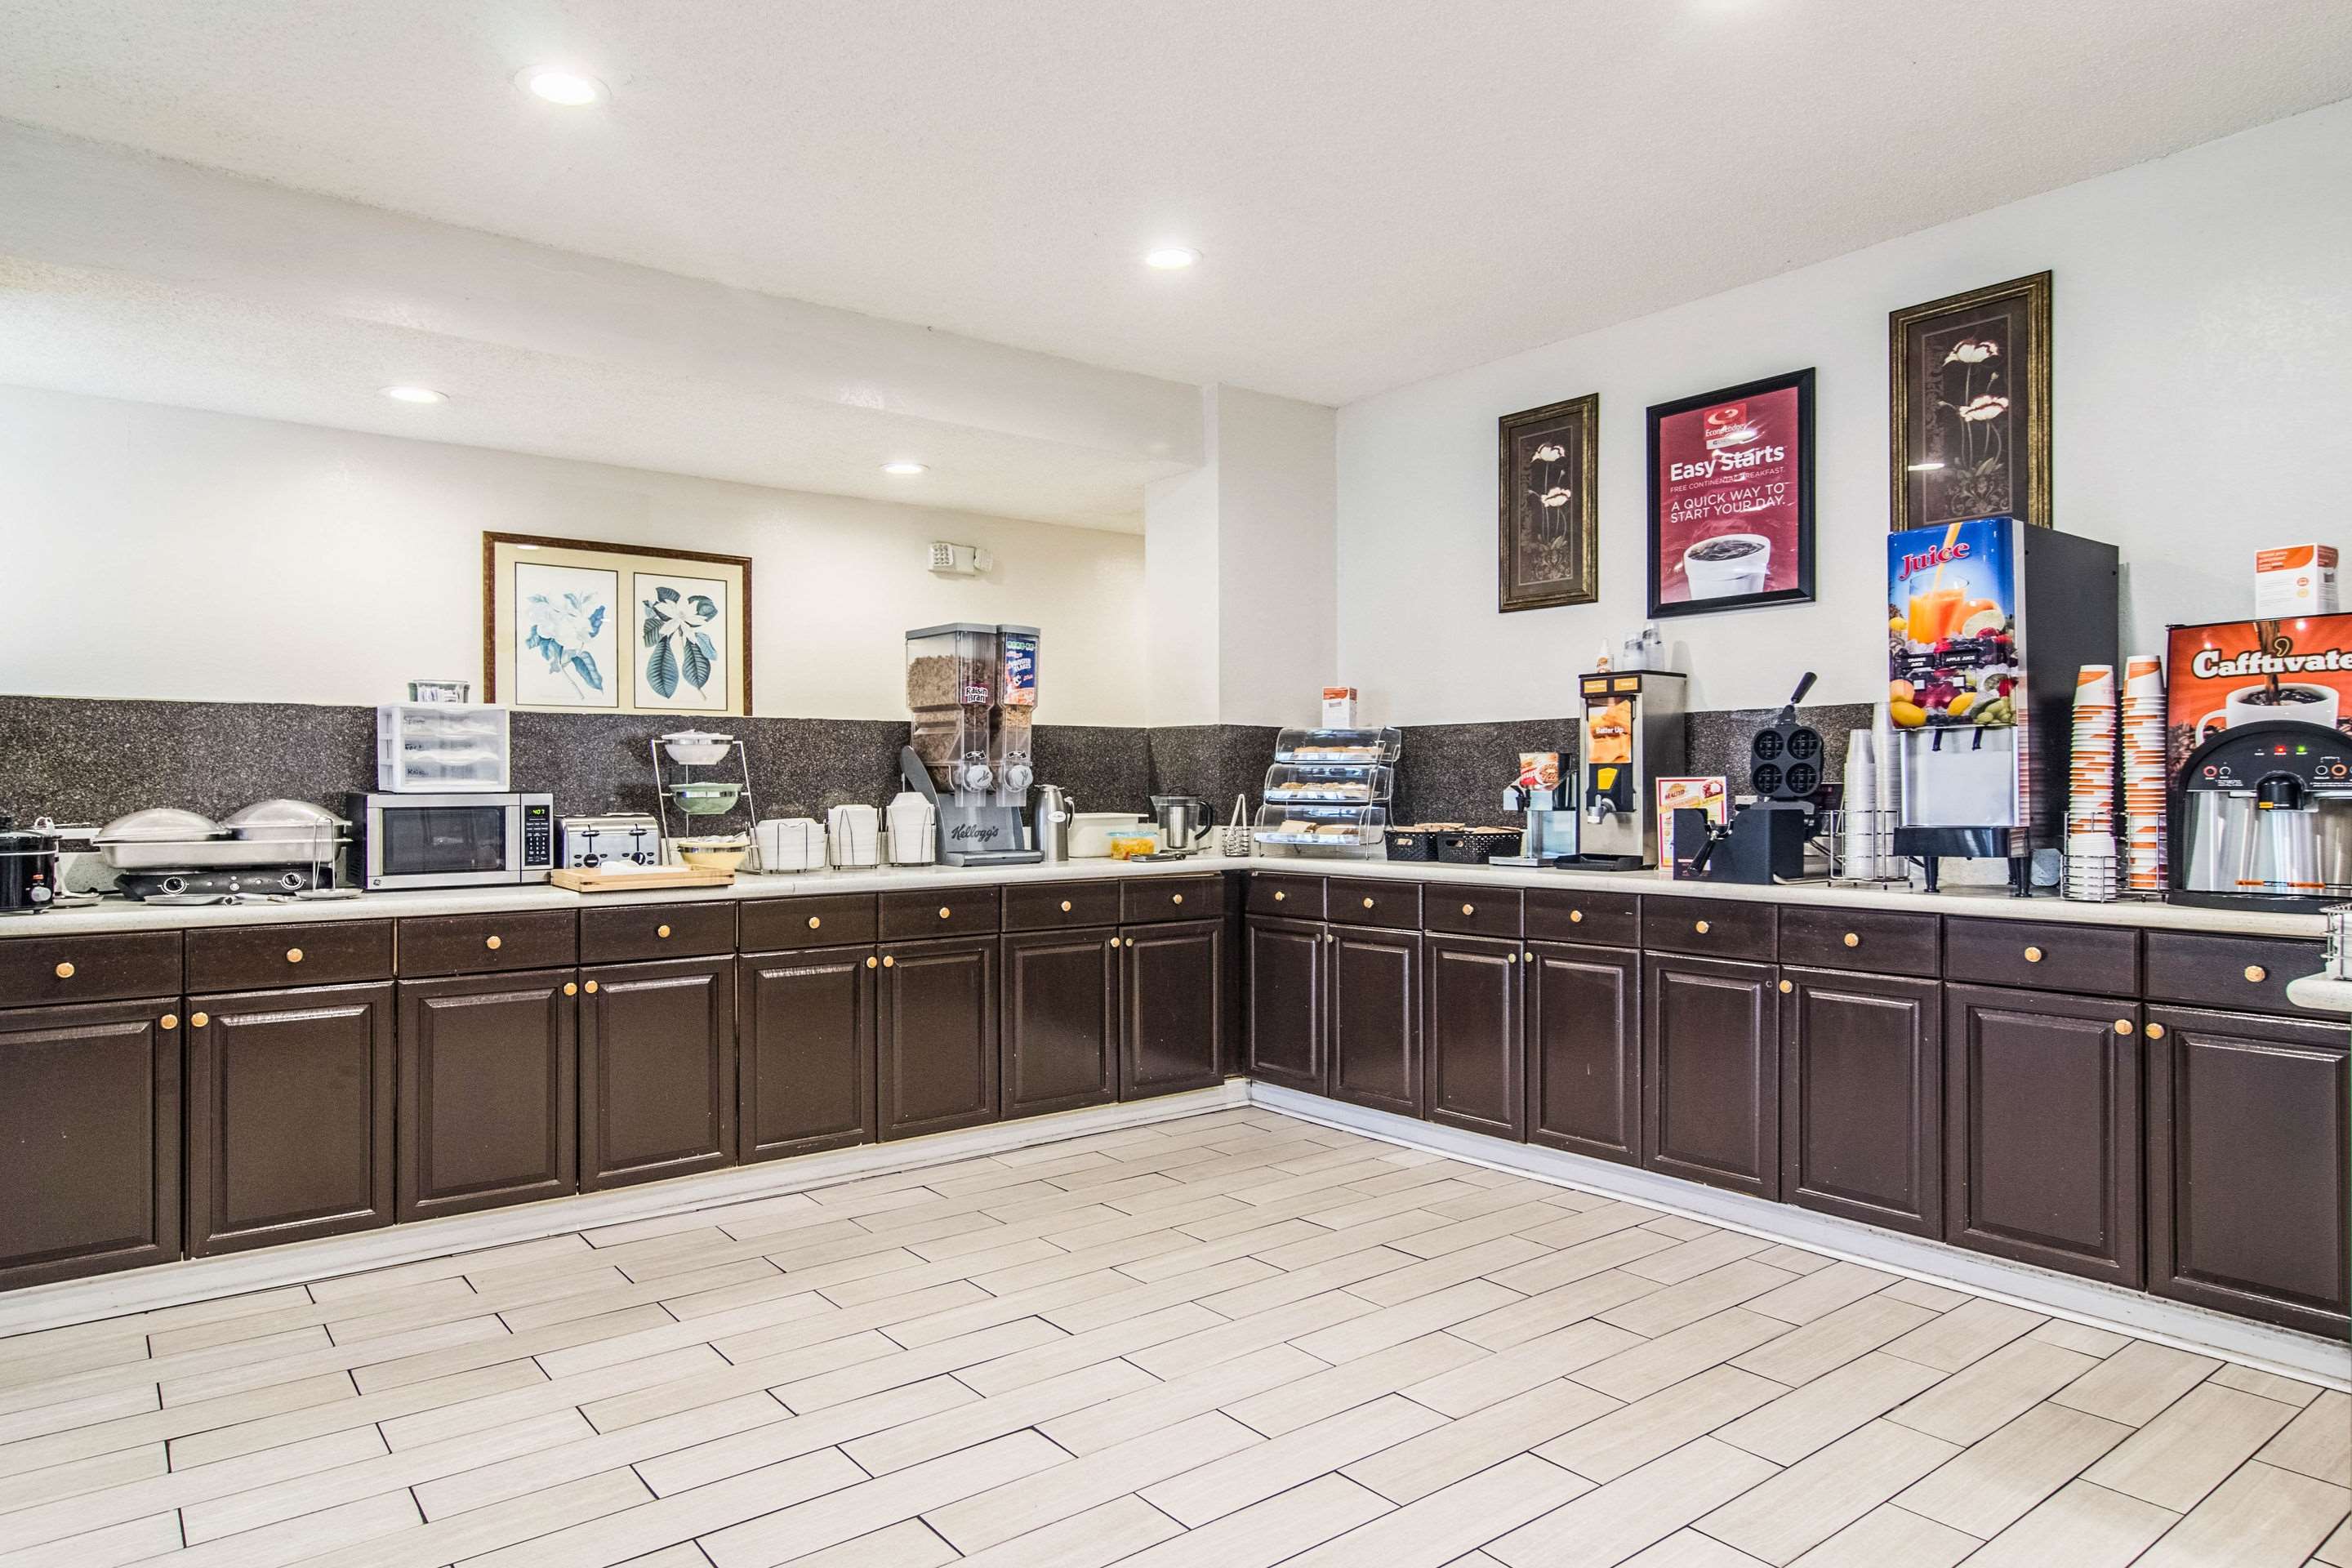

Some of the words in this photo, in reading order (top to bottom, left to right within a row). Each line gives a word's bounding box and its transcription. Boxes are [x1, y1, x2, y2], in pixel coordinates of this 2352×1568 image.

[1671, 459, 1716, 481] Easy
[1720, 445, 1784, 470] Starts
[1670, 484, 1688, 493] FREE
[1671, 501, 1680, 512] A
[1684, 492, 1726, 510] QUICK
[1730, 486, 1761, 501] WAY
[1765, 483, 1784, 495] TO
[1671, 507, 1710, 523] START
[1714, 501, 1752, 516] YOUR
[1756, 494, 1786, 508] DAY.
[1899, 542, 1970, 581] Juice
[966, 687, 987, 695] Raisin
[968, 694, 986, 702] Bran
[951, 823, 1000, 842] Kellogg's
